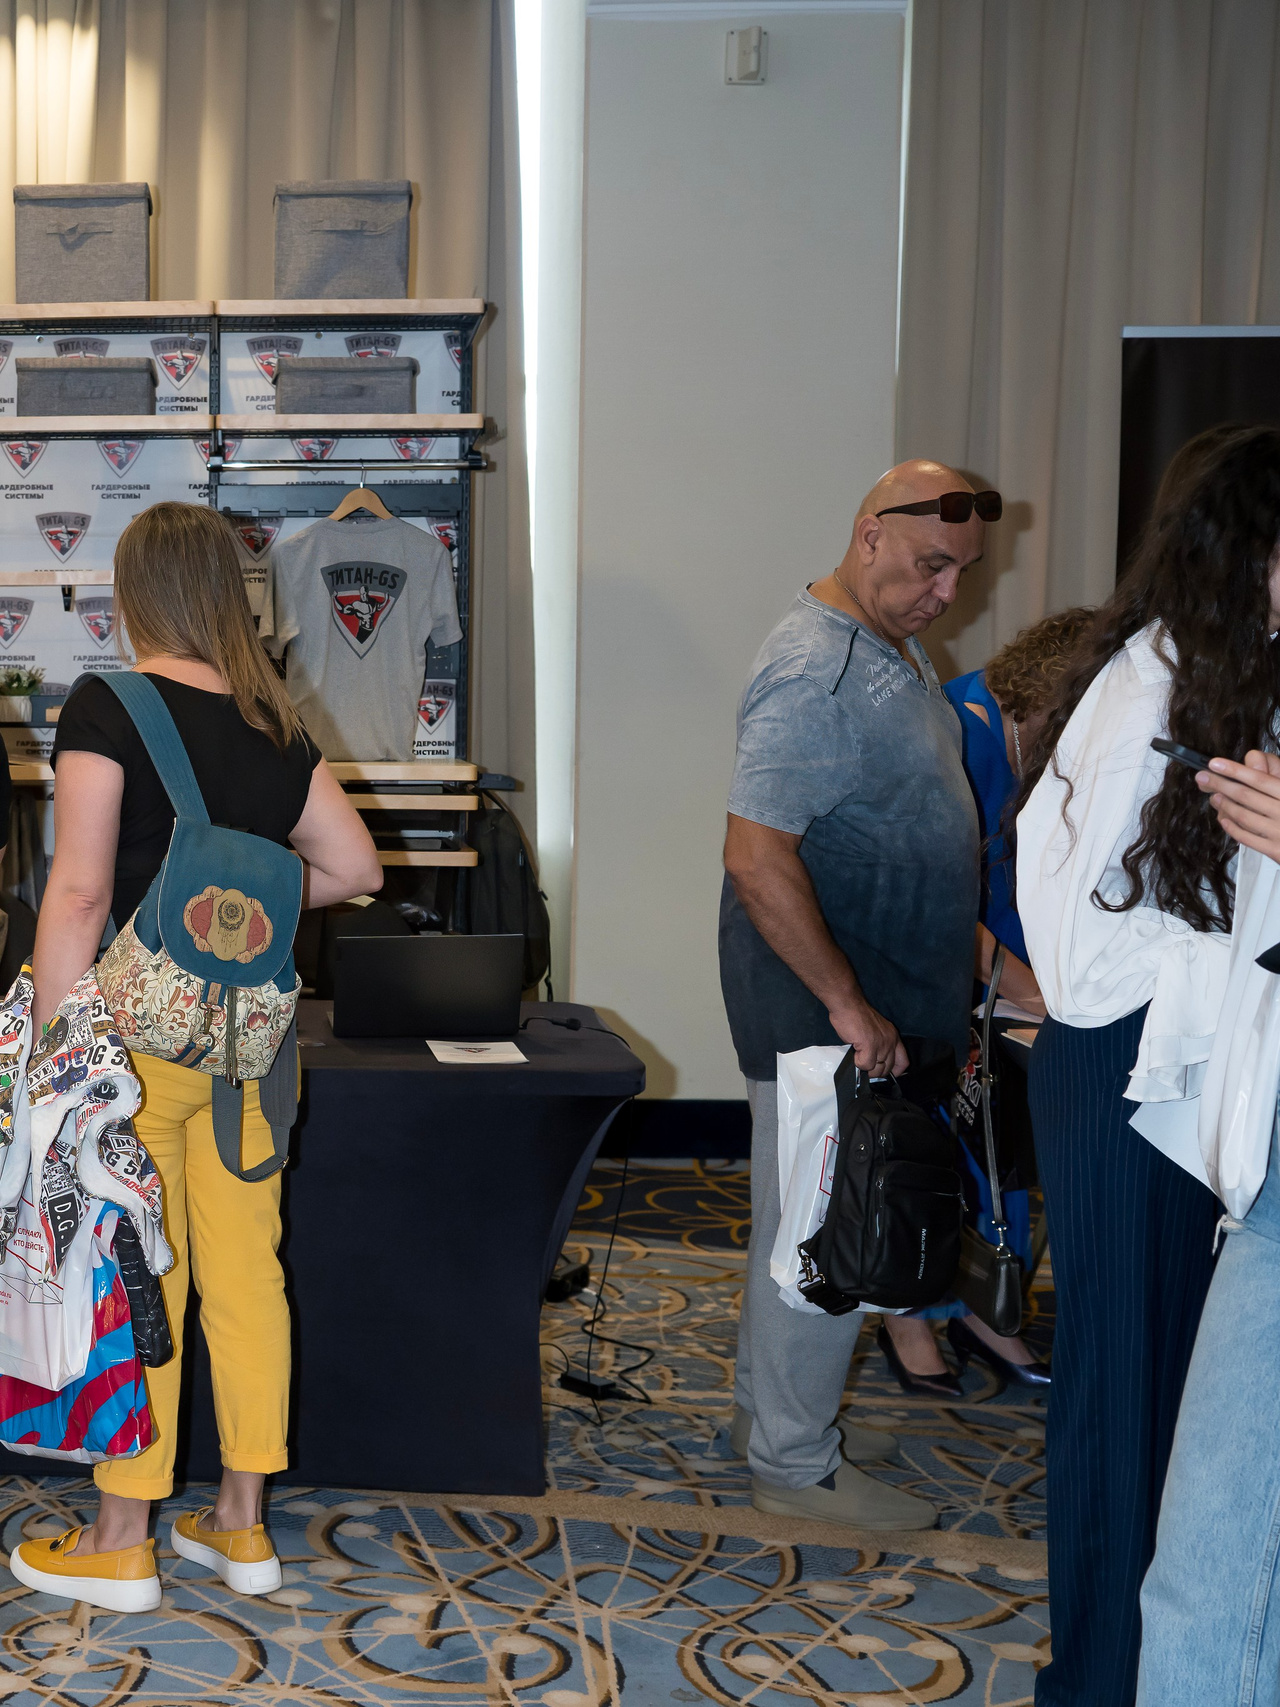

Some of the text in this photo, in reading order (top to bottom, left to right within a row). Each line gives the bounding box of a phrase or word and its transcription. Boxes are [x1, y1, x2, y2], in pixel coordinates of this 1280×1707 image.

[328, 568, 400, 590] ТИТАН-GS
[871, 687, 892, 707] LAKE
[13, 1239, 25, 1248] КТО
